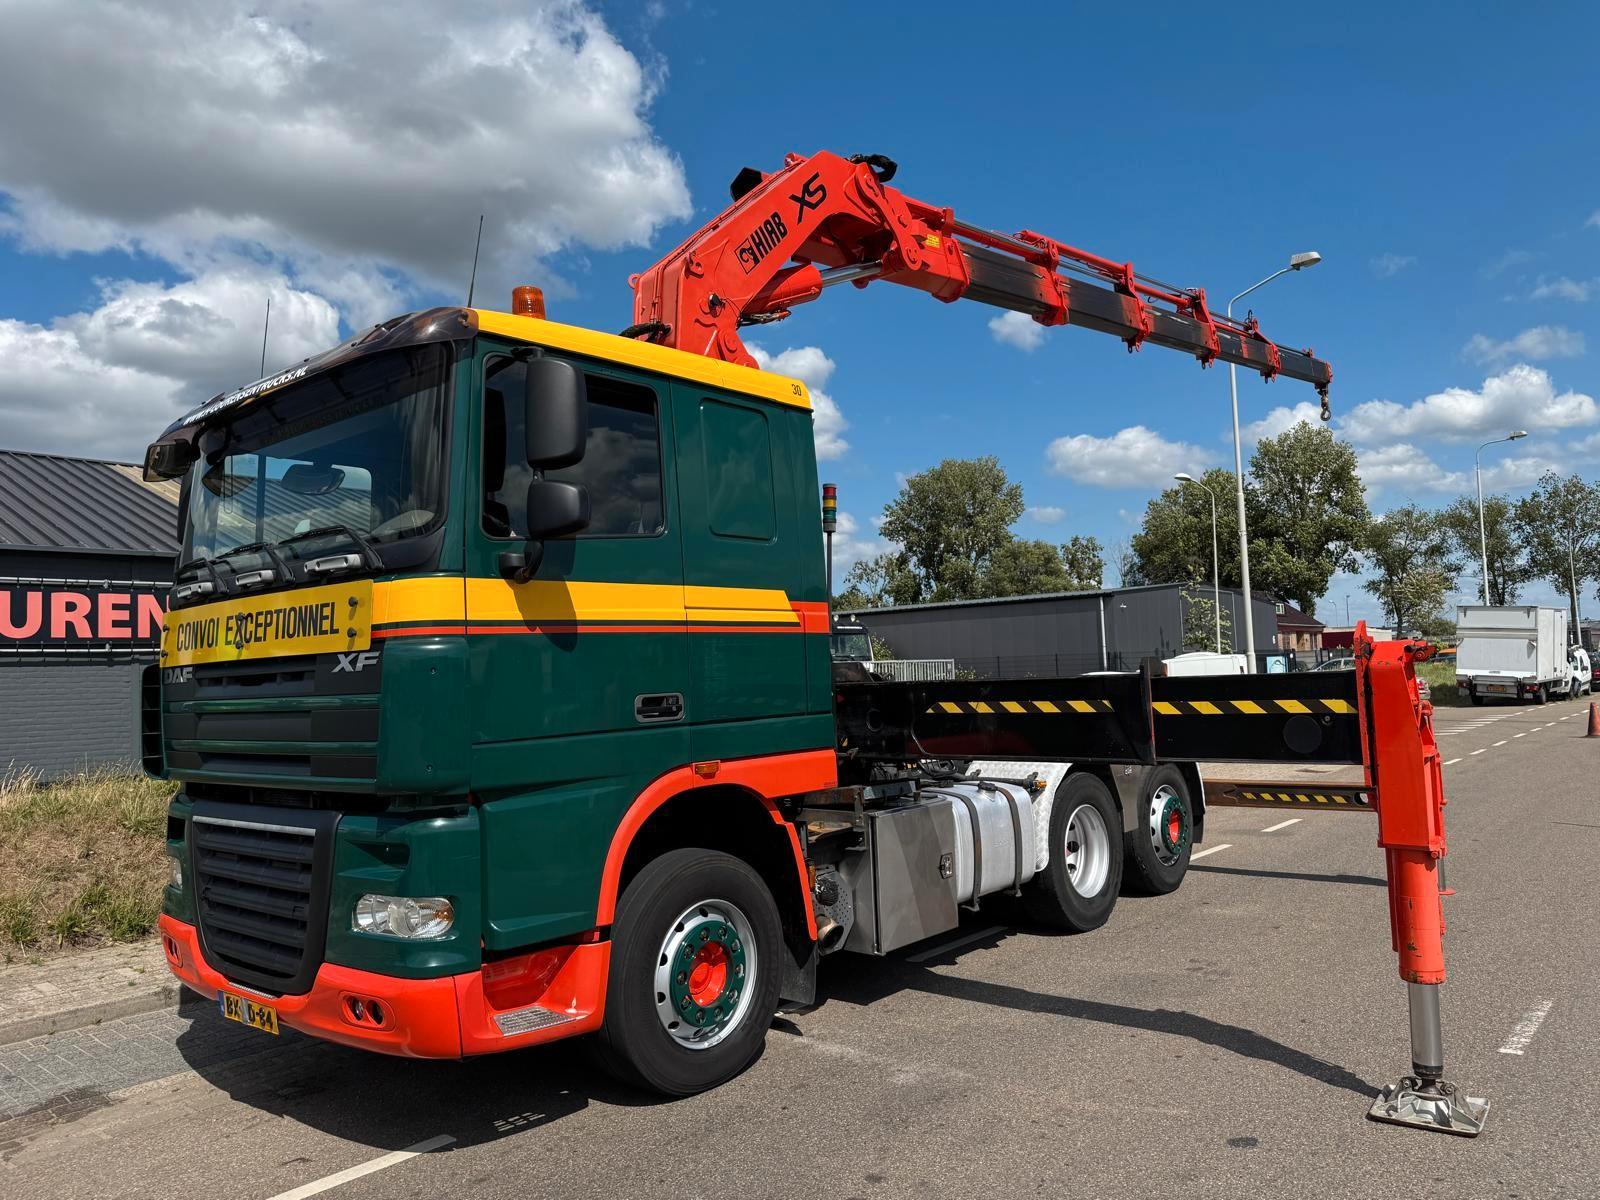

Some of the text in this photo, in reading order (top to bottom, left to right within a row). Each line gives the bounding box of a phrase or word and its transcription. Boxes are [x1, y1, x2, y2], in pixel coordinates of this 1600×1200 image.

[750, 171, 828, 260] HIAB XS
[791, 383, 802, 397] 30
[176, 601, 340, 652] CONVOI EXCEPTIONNEL
[331, 651, 381, 673] XF
[163, 666, 193, 684] DAF
